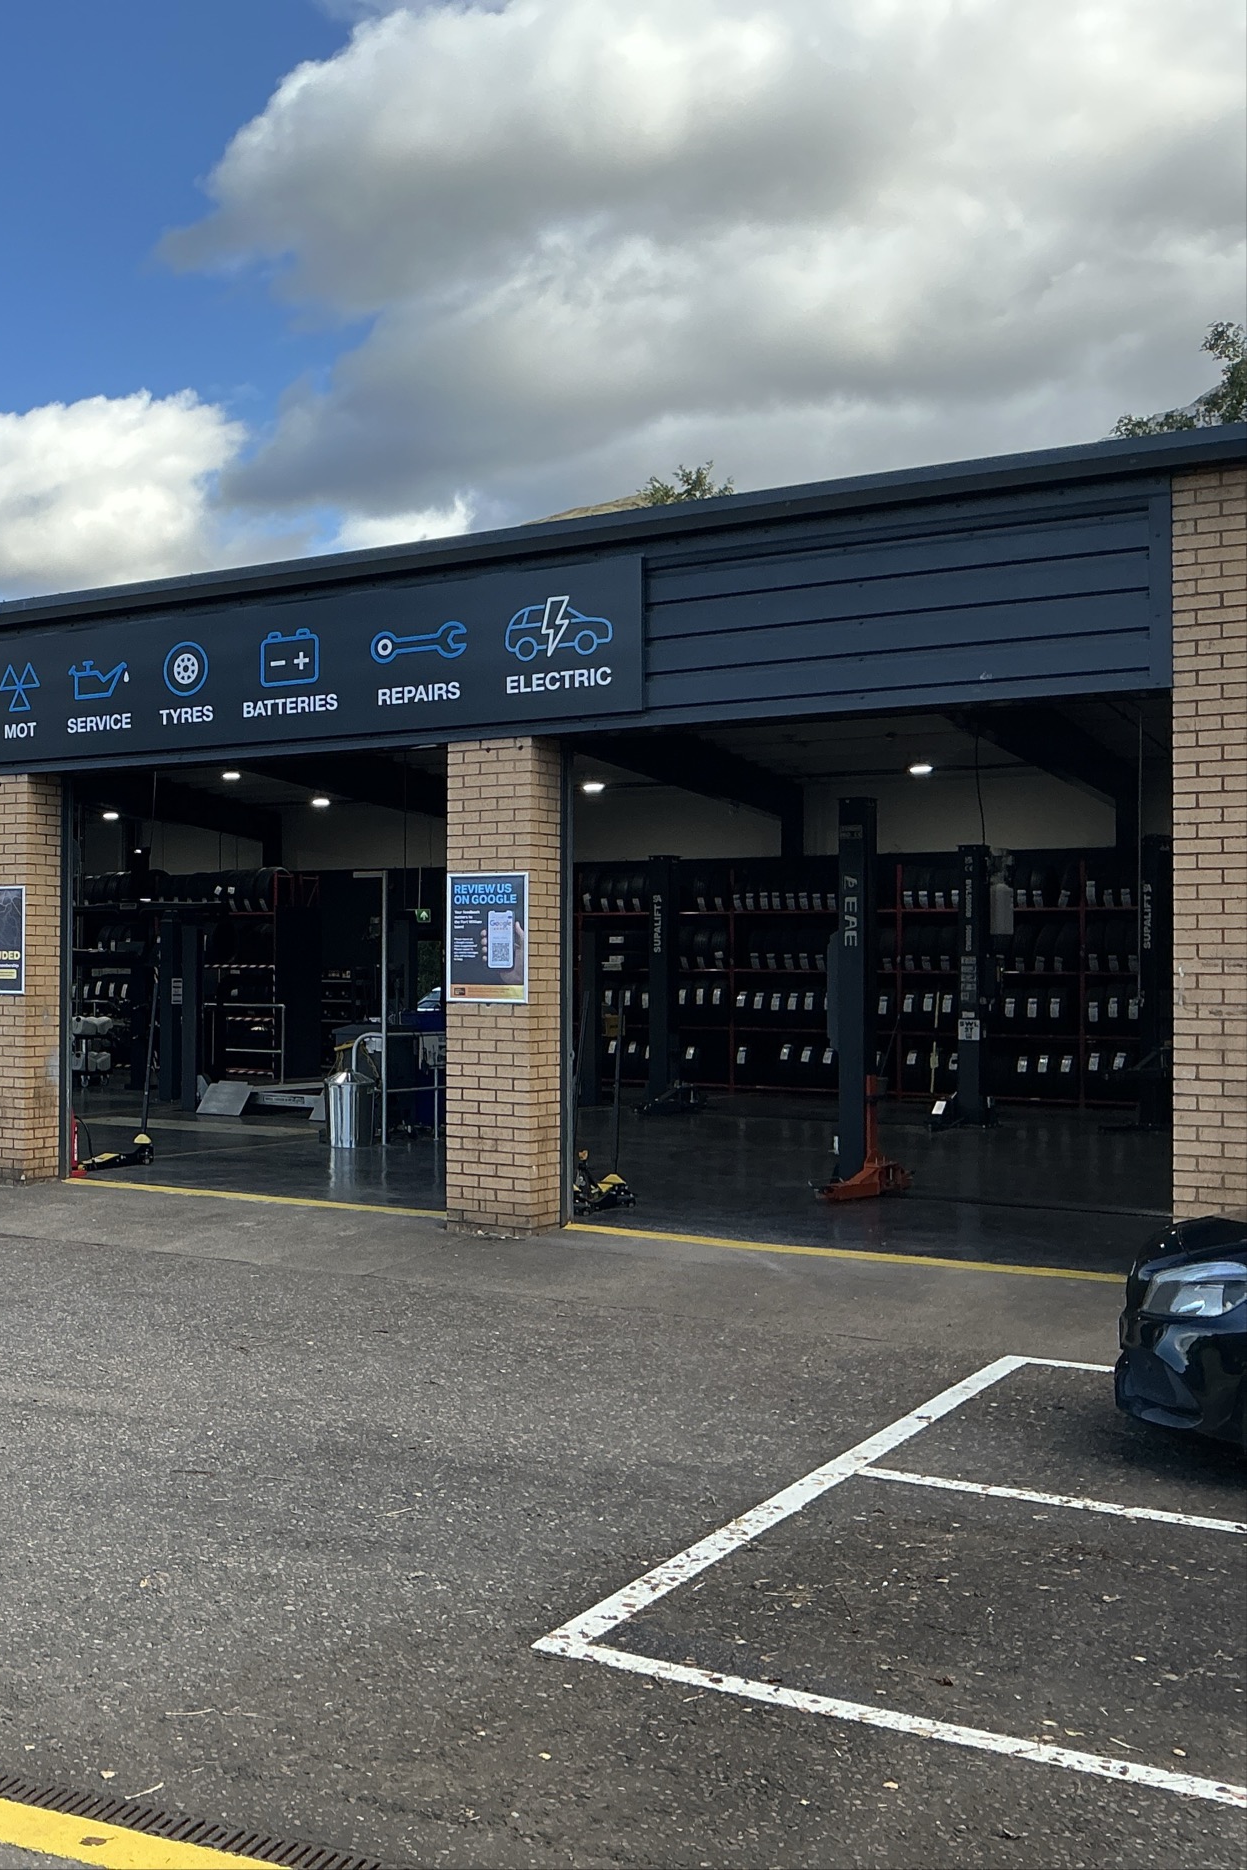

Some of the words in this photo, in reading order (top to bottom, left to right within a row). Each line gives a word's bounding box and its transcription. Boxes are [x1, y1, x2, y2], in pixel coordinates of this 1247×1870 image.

[505, 666, 612, 694] ELECTRIC
[377, 681, 461, 706] REPAIRS
[159, 704, 214, 726] TYRES
[242, 692, 338, 719] BATTERIES
[4, 721, 36, 740] MOT
[66, 712, 131, 734] SERVICE
[454, 884, 496, 894] REVIEW
[497, 883, 512, 893] US
[454, 895, 469, 905] ON
[471, 894, 517, 904] GOOGLE
[490, 919, 512, 928] Google
[653, 904, 662, 953] SUPALIFT
[844, 896, 858, 947] EAE
[1143, 894, 1152, 949] SUPALIFT
